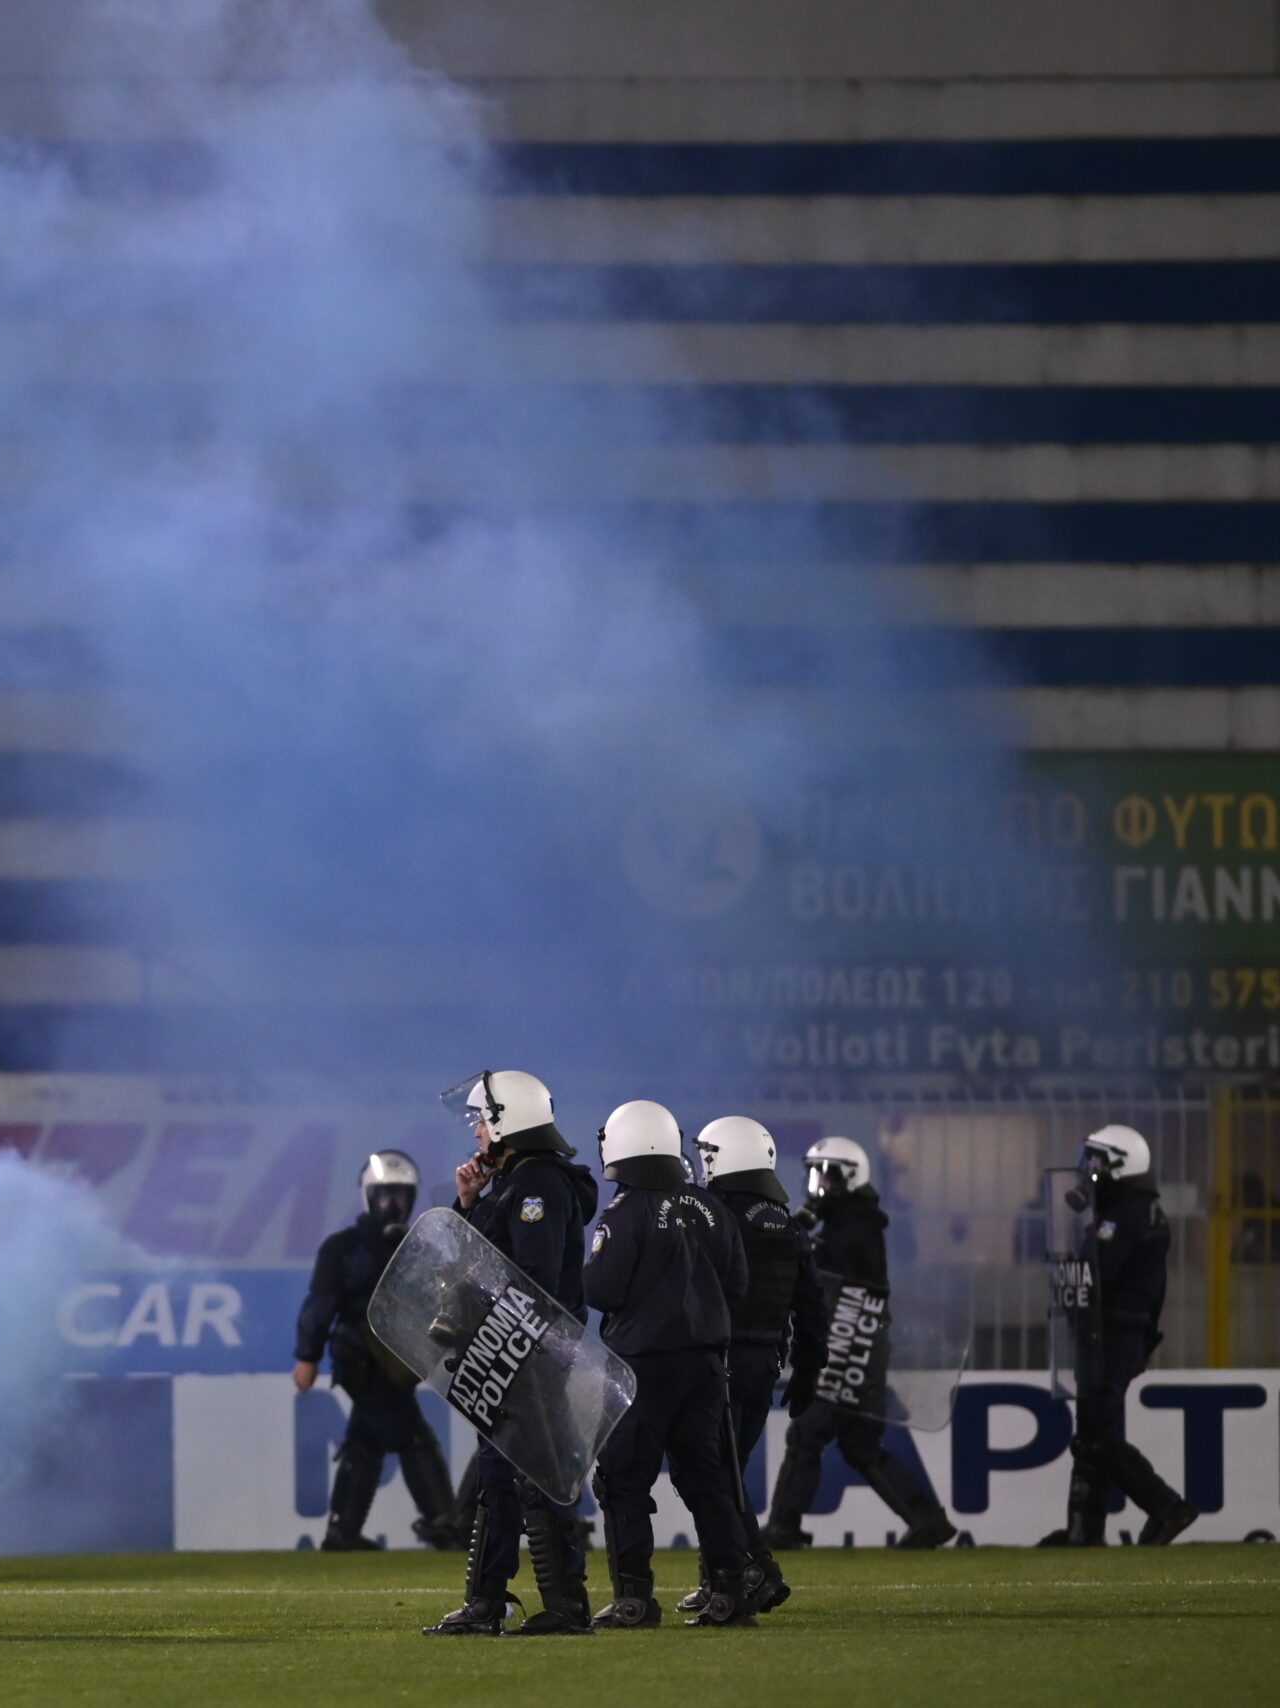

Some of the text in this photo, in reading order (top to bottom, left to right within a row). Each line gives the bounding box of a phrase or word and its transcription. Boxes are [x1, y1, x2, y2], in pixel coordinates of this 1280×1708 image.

[1113, 792, 1278, 850] ΦΥΤΩ
[1121, 969, 1193, 1010] 210
[741, 1022, 1280, 1074] Volioti Fyta Peristeri
[680, 1195, 716, 1228] ΑΣΤΥΝΟΜΙΑ
[1051, 1287, 1089, 1308] LICE
[1052, 1261, 1093, 1287] ΝΟΜΙΑ
[56, 1282, 243, 1349] CAR
[450, 1286, 536, 1415] ΑΣΤΥΝΟΜΙΑ
[474, 1308, 549, 1427] POLICE
[816, 1286, 868, 1404] ΑΣΤΥΝΟΜΙΑ
[841, 1295, 885, 1404] POLICE
